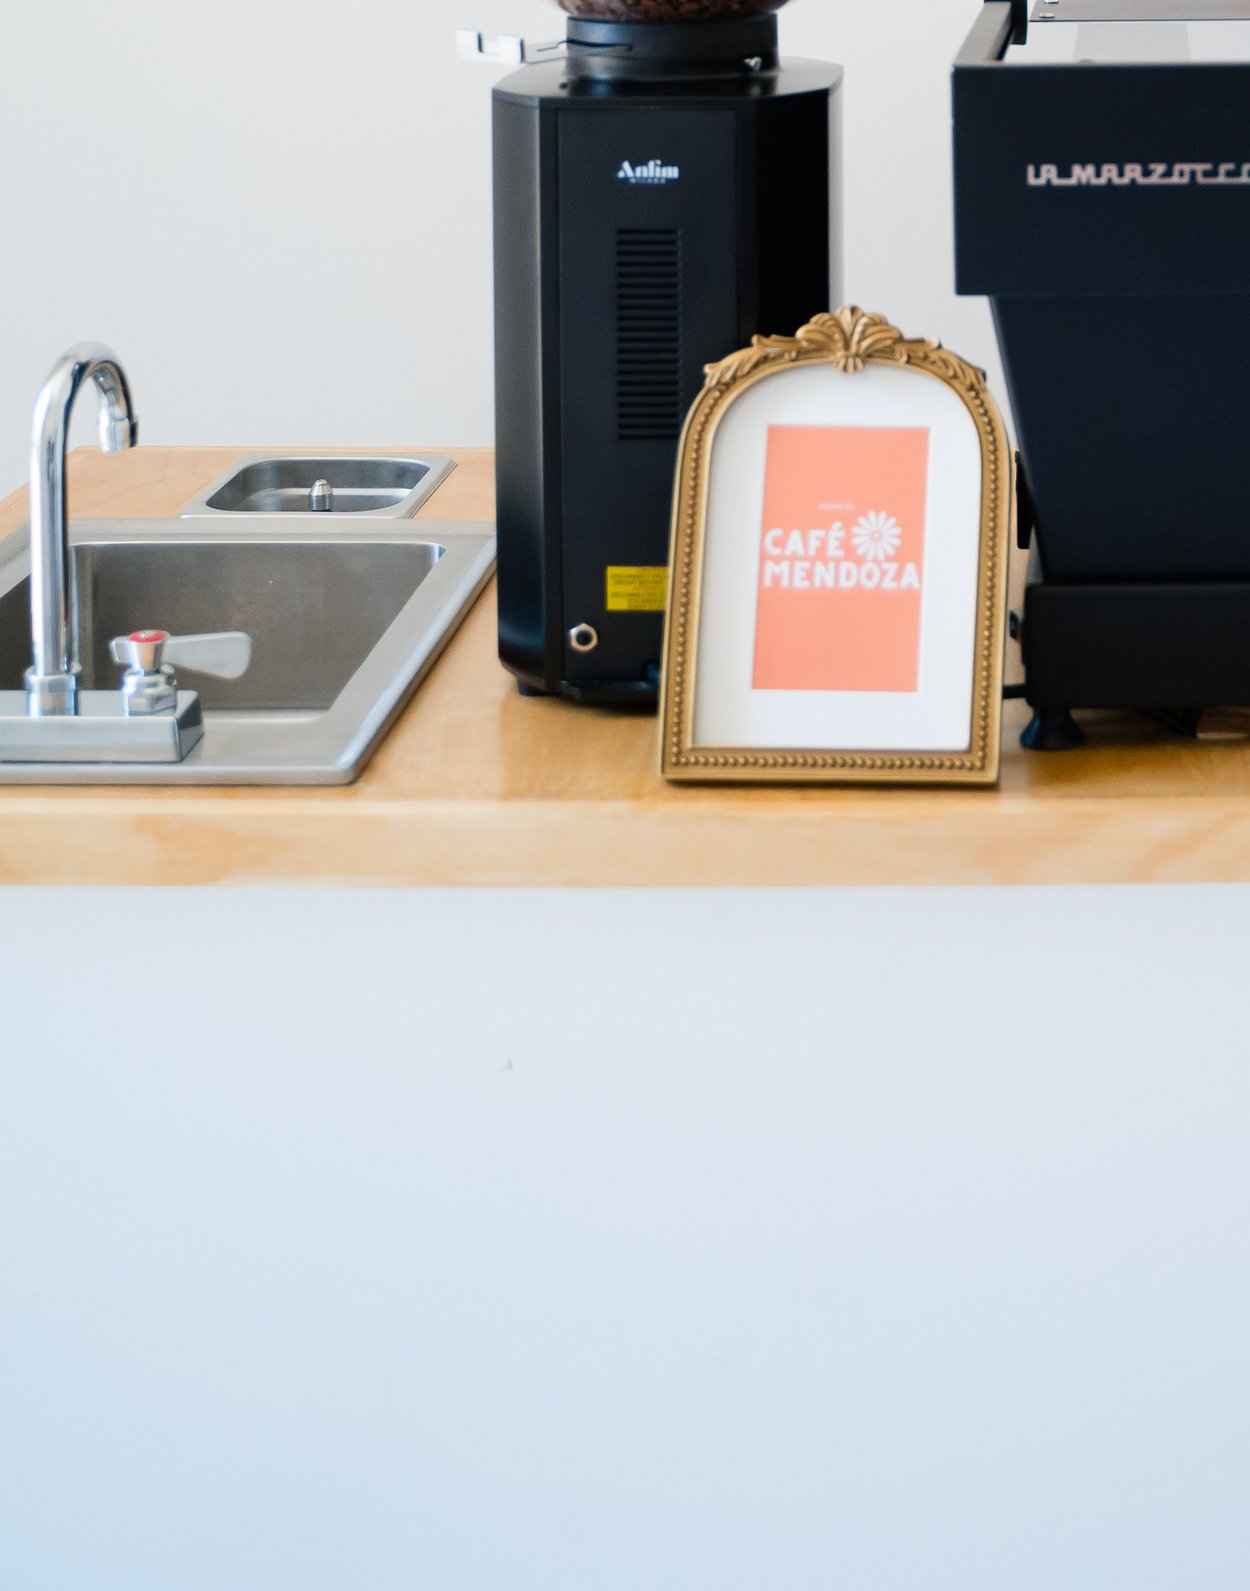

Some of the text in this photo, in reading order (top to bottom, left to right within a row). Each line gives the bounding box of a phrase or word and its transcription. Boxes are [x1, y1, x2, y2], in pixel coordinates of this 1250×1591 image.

[617, 159, 679, 178] Anfim
[764, 521, 846, 557] CAFÉ
[763, 560, 921, 589] MENDOZA
